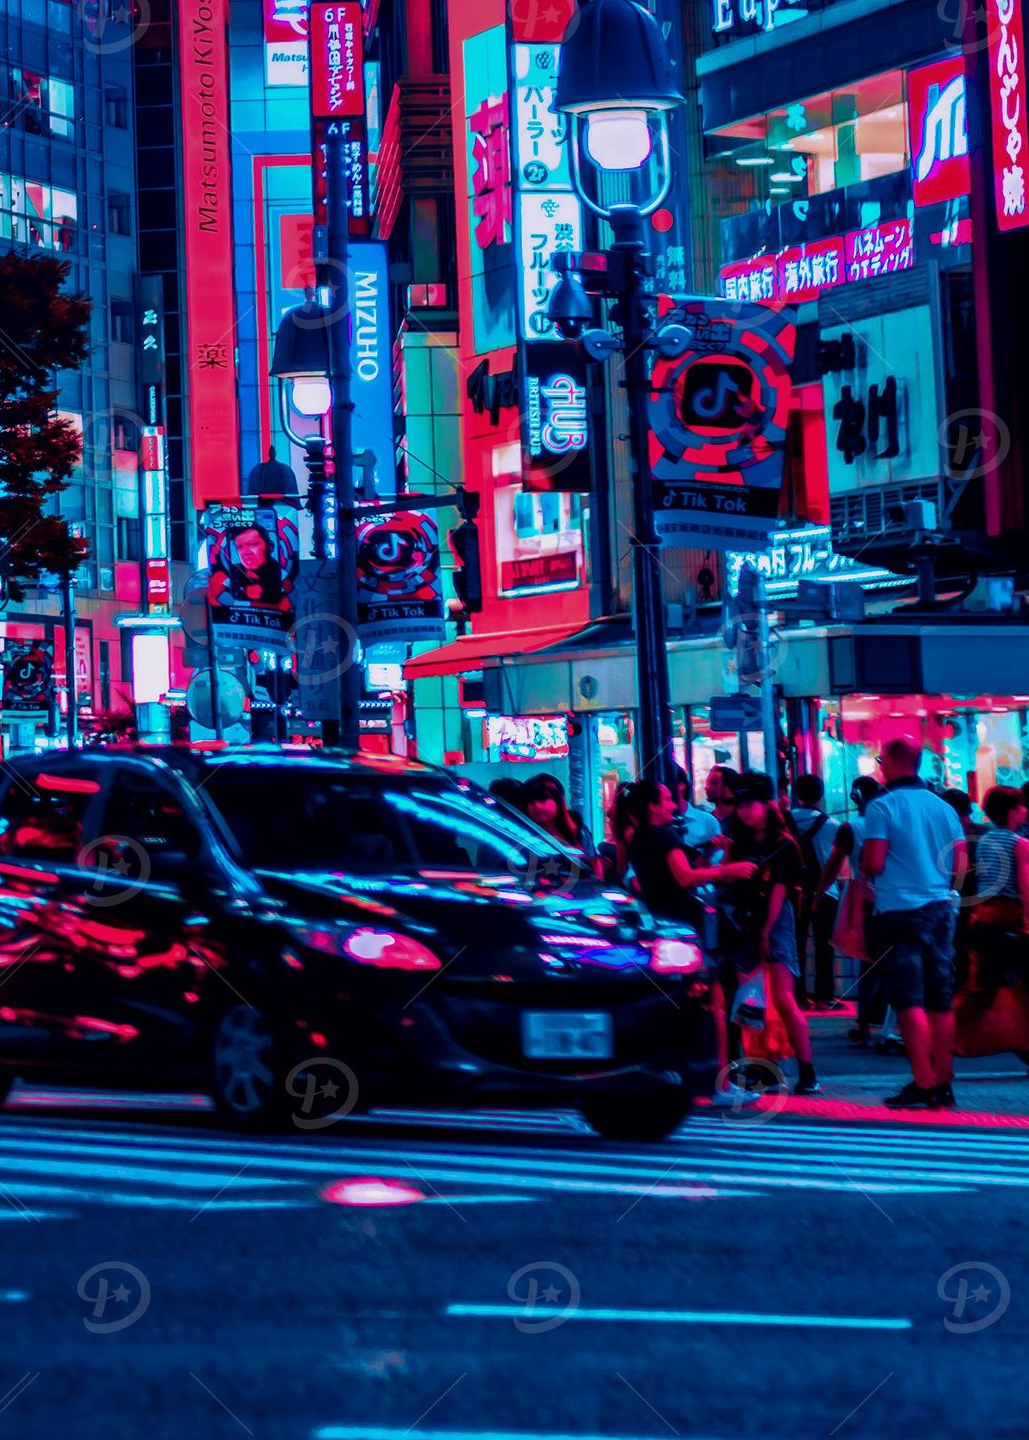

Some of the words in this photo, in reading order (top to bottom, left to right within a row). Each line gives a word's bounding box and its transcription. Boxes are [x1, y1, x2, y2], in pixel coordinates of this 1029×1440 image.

[324, 7, 346, 22] 6F
[524, 86, 545, 156] パーラー
[197, 73, 219, 233] Matsumoto
[530, 233, 550, 306] フルーツ
[725, 266, 774, 303] 国内旅行
[785, 250, 839, 294] 海外旅行
[354, 271, 379, 381] MIZUHO
[541, 373, 588, 454] HUB
[682, 492, 707, 508] Tik
[716, 492, 747, 512] Tok
[244, 613, 262, 625] Tik
[264, 615, 282, 627] Tok
[381, 608, 399, 618] Tik
[404, 606, 425, 617] Tok
